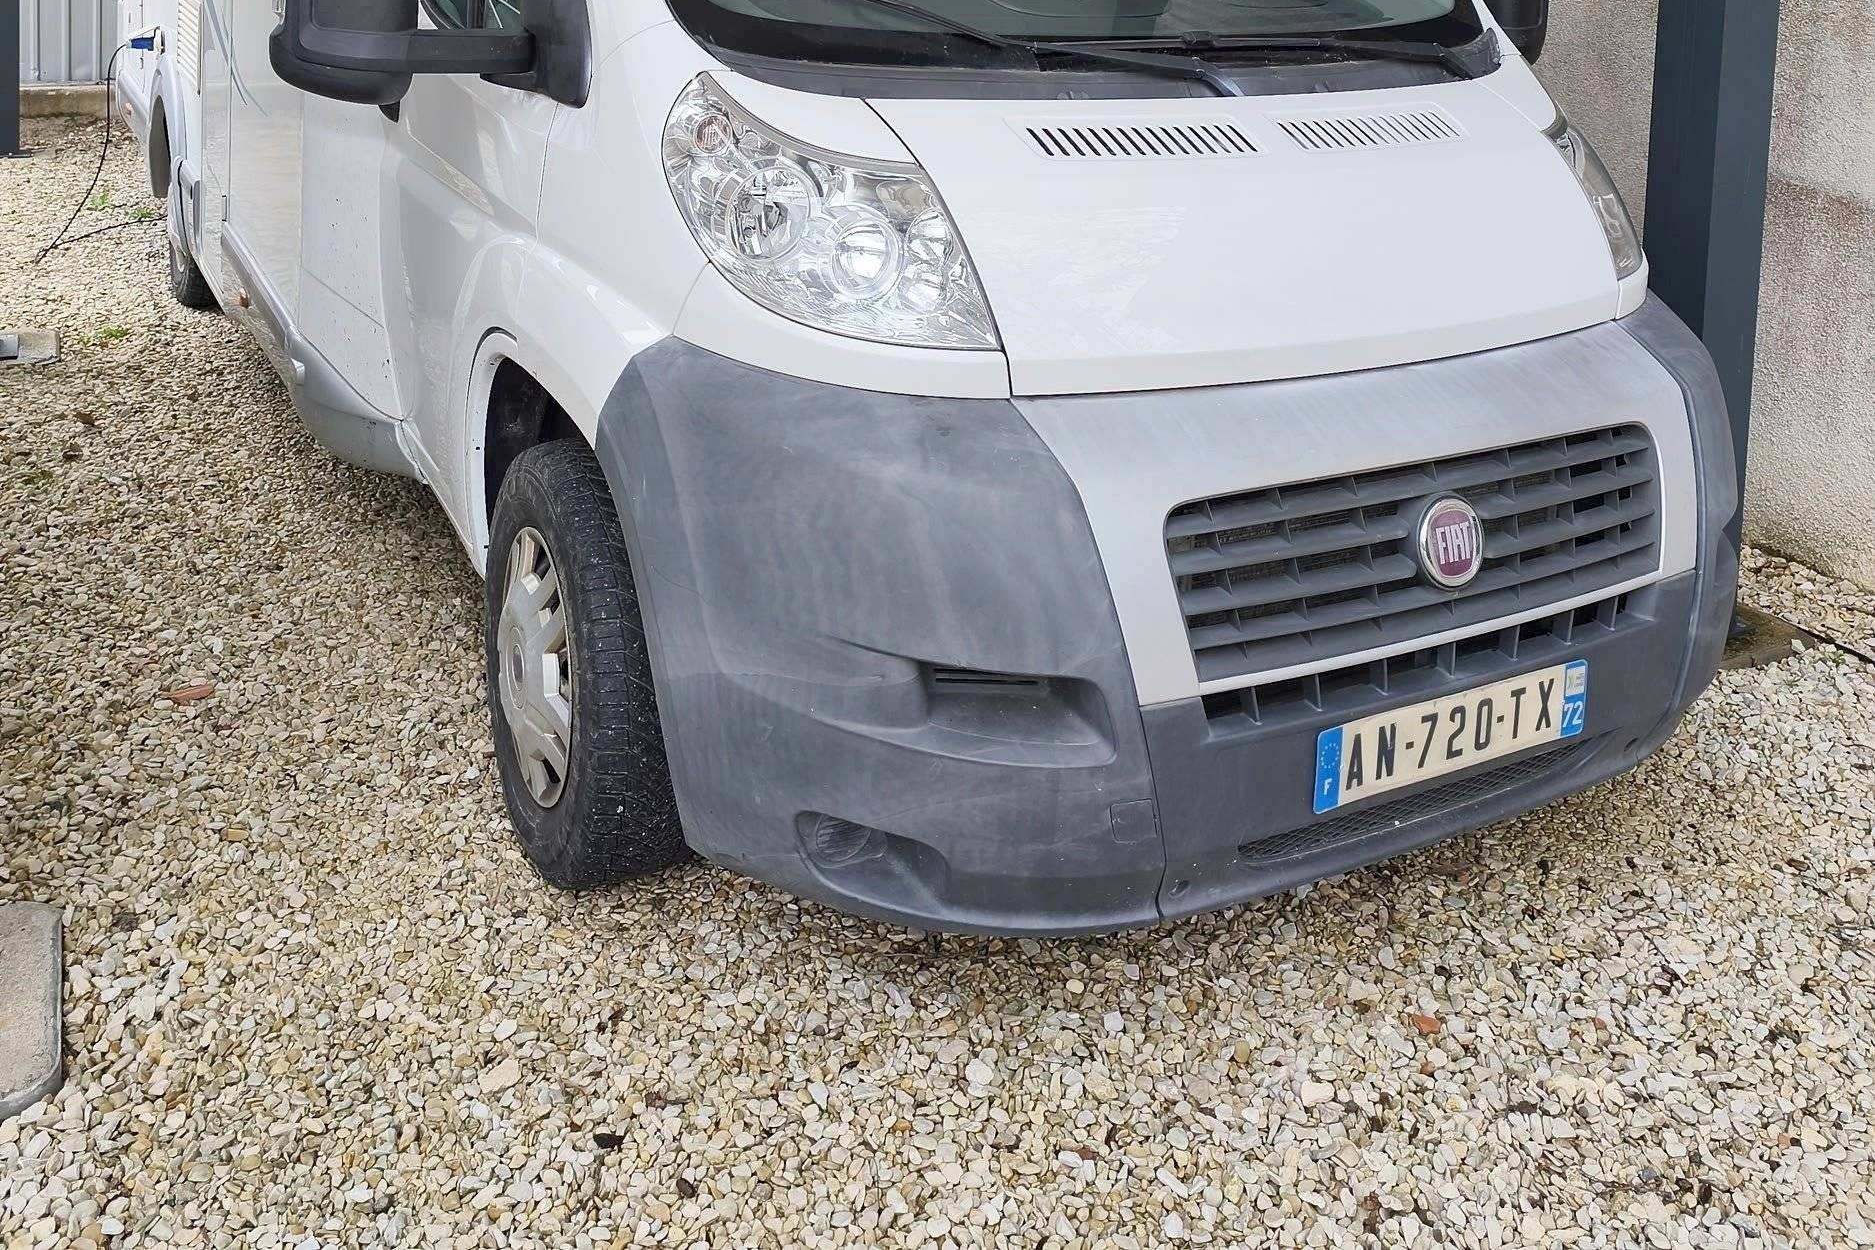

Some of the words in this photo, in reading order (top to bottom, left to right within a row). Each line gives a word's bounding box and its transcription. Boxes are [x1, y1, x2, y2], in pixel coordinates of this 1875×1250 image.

[1435, 520, 1471, 565] FIAT
[1562, 700, 1584, 728] 72
[1345, 678, 1554, 791] AN-720-TX
[1323, 777, 1333, 796] F
